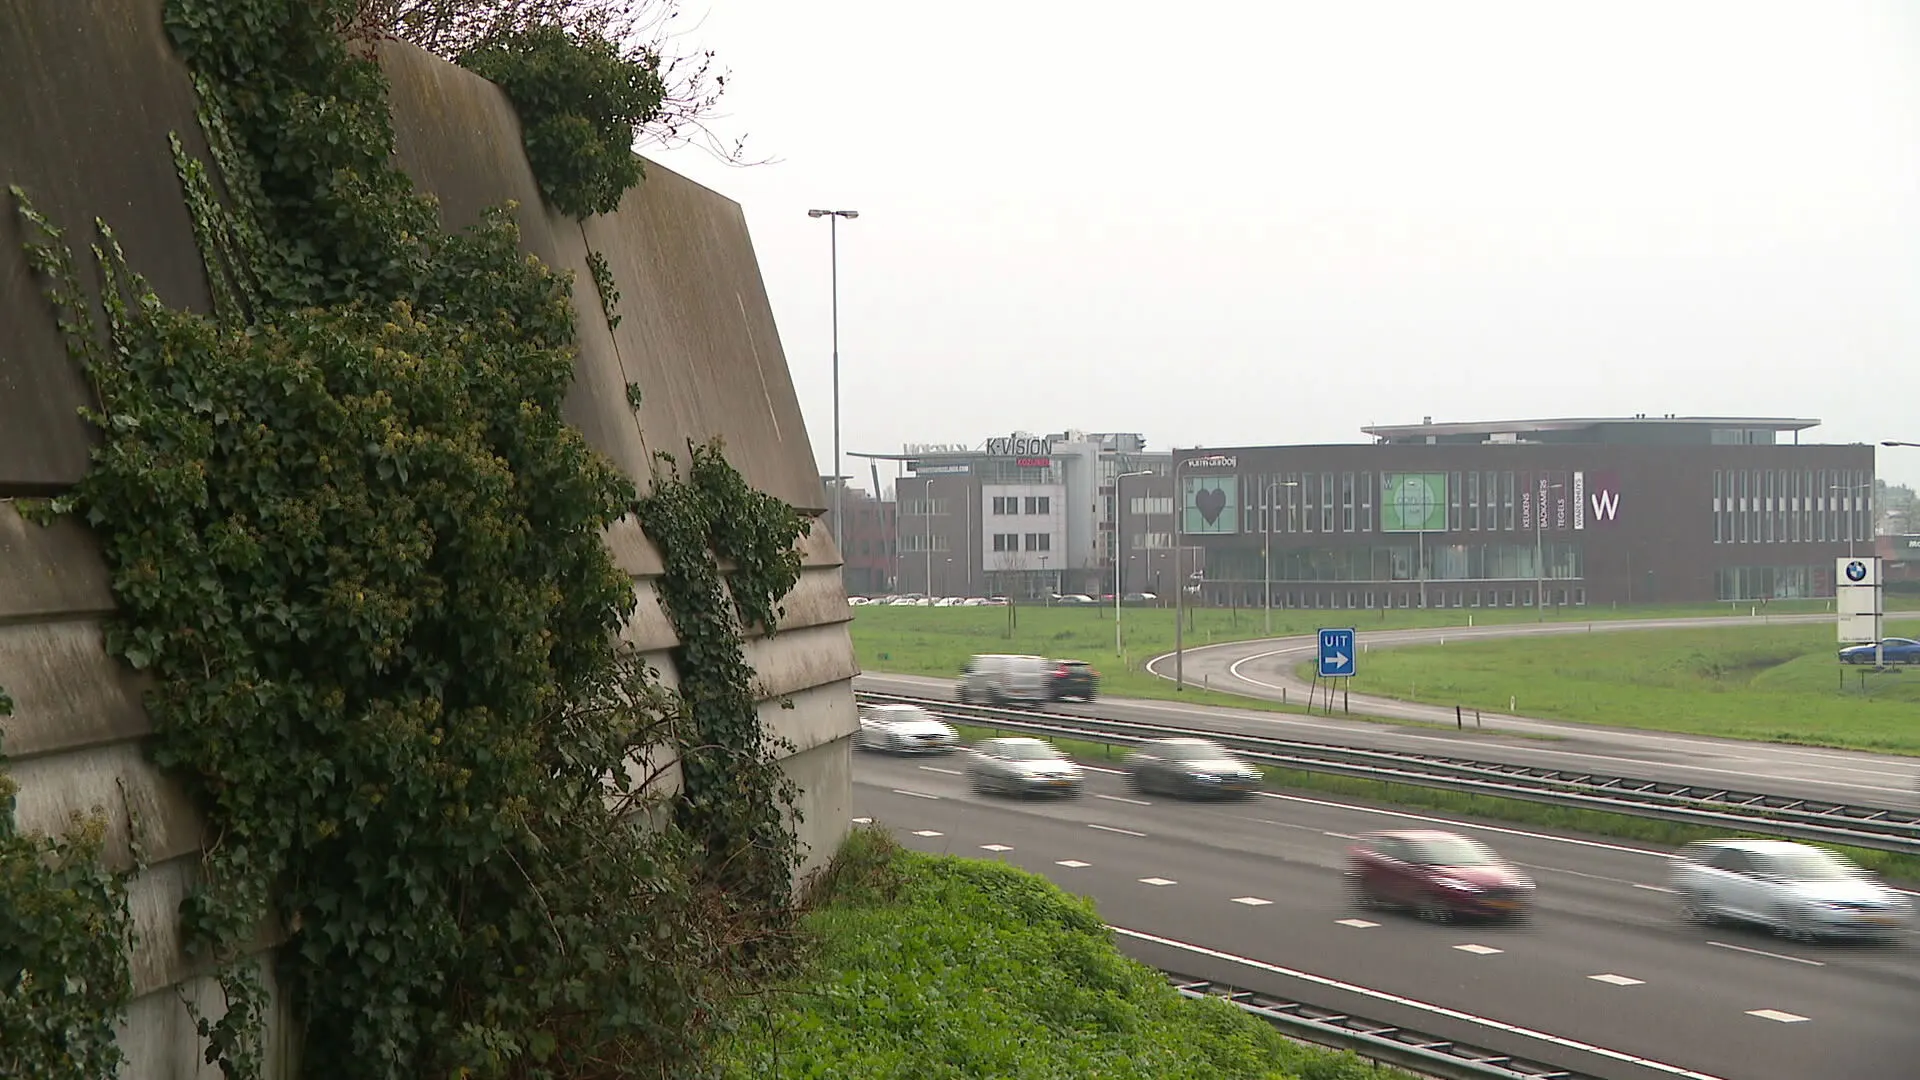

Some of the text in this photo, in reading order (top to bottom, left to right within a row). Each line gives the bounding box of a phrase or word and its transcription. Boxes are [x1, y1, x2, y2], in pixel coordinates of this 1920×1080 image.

[1522, 492, 1530, 528] KEUKENS
[1540, 479, 1548, 528] BADKAMERS
[1557, 498, 1565, 527] TEGELS
[1591, 489, 1619, 520] W
[1325, 635, 1348, 647] UIT
